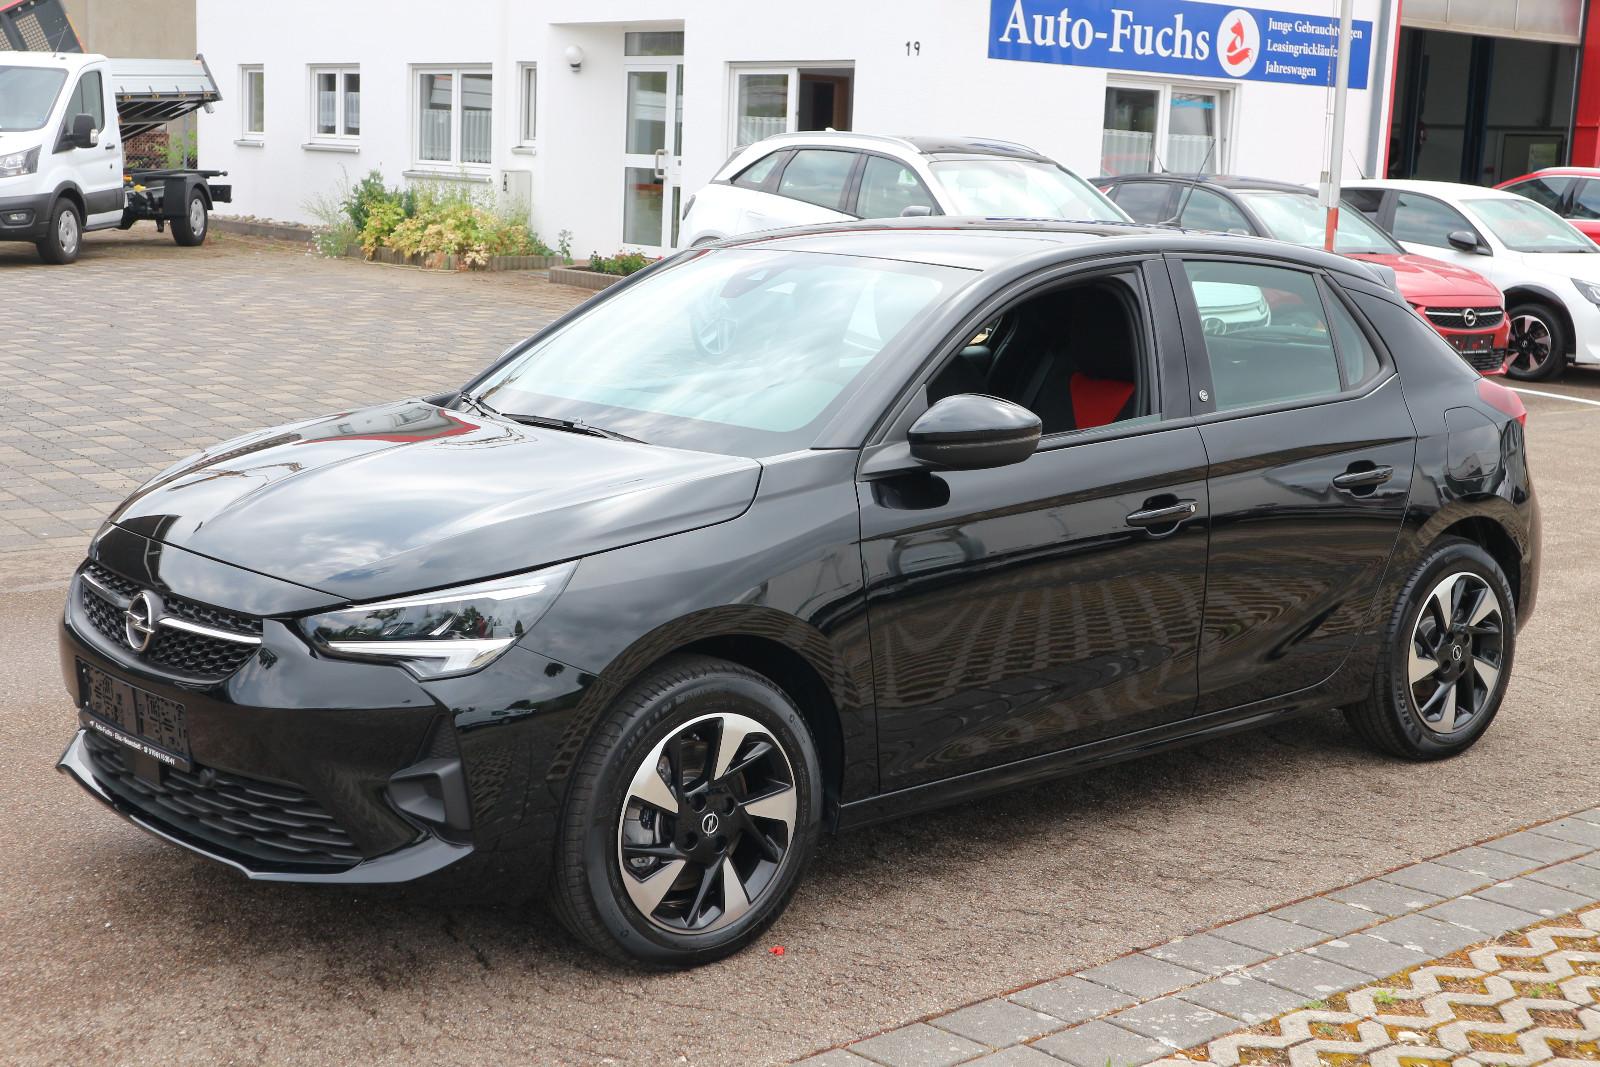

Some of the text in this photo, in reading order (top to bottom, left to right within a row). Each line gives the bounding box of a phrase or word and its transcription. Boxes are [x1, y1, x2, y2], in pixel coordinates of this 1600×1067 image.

[998, 0, 1210, 61] Auto-Fuchs
[1268, 17, 1293, 35] Junge
[905, 41, 921, 57] 19
[1267, 39, 1338, 58] Leasingrückläufe
[1265, 61, 1317, 80] Jahreswagen
